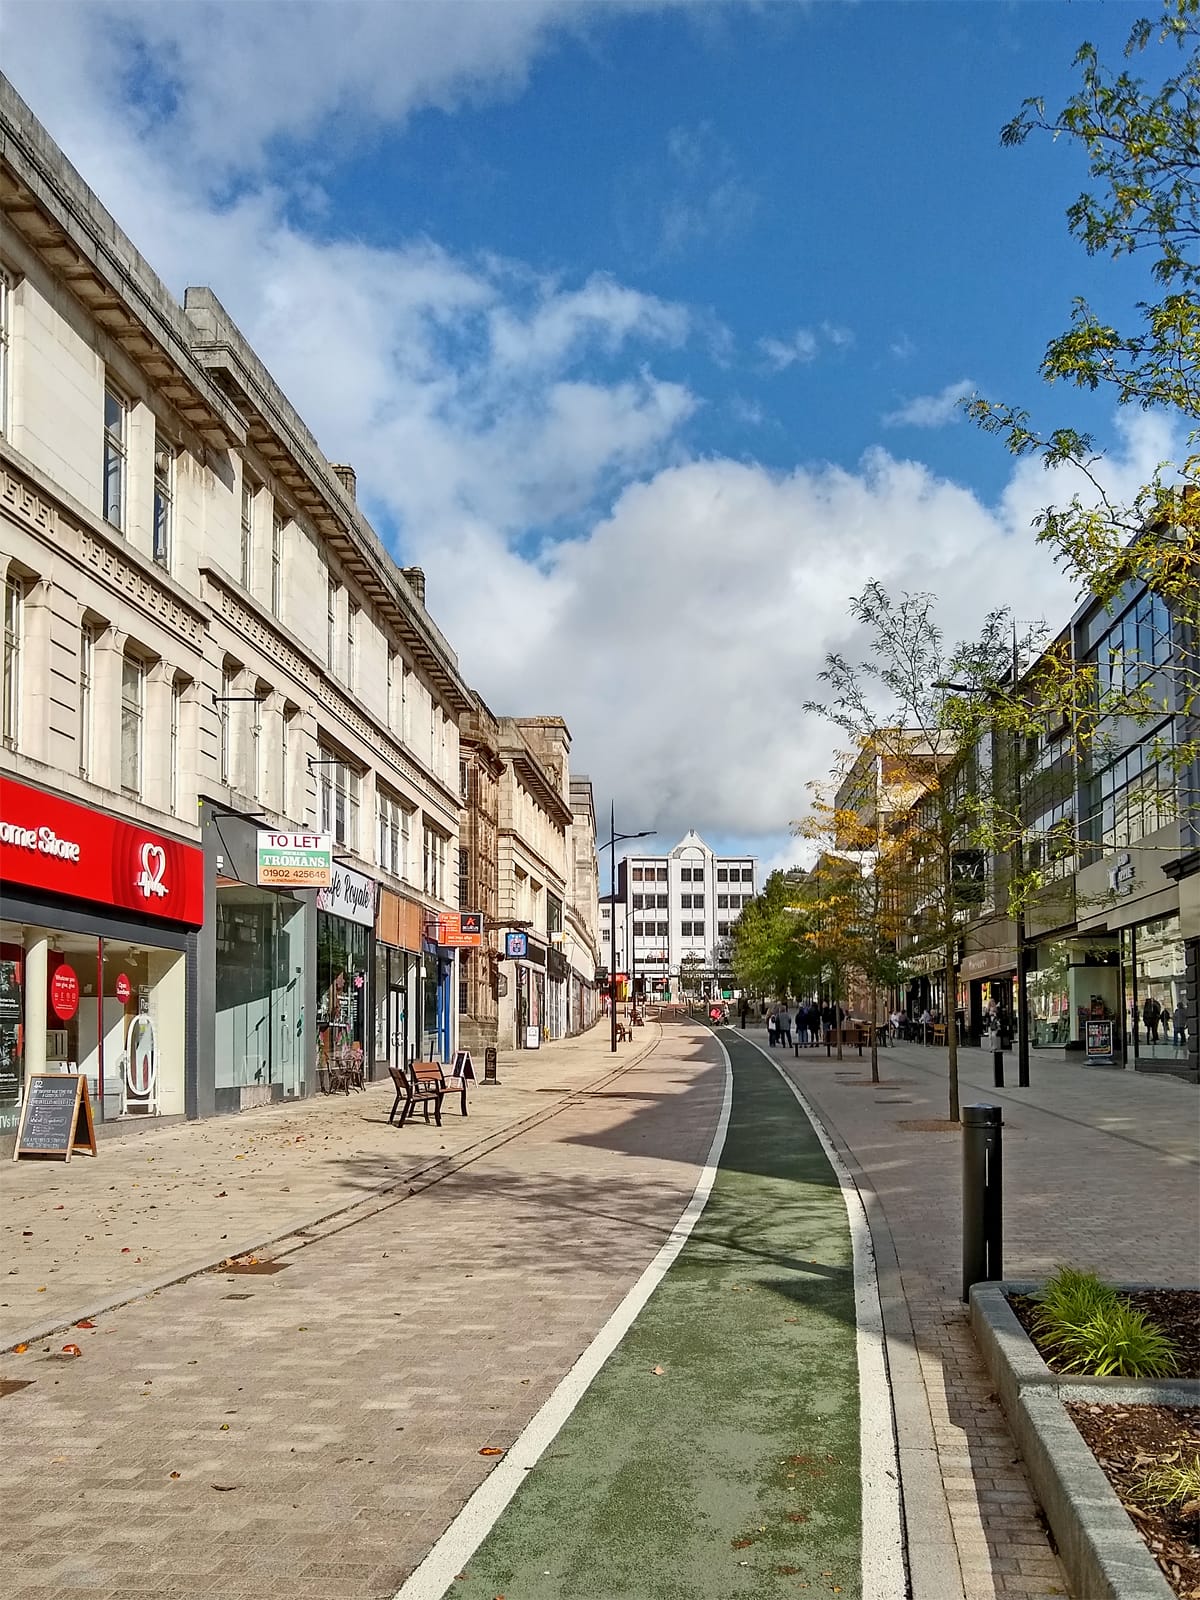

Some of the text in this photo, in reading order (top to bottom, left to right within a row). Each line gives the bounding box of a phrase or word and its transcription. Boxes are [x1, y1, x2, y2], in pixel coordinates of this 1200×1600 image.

[38, 827, 80, 861] Store
[268, 835, 321, 848] TO LET
[264, 856, 325, 867] TROMANS
[263, 869, 326, 879] 01902 425646
[956, 864, 979, 879] W
[344, 874, 370, 915] Royale
[0, 1115, 11, 1128] TVs
